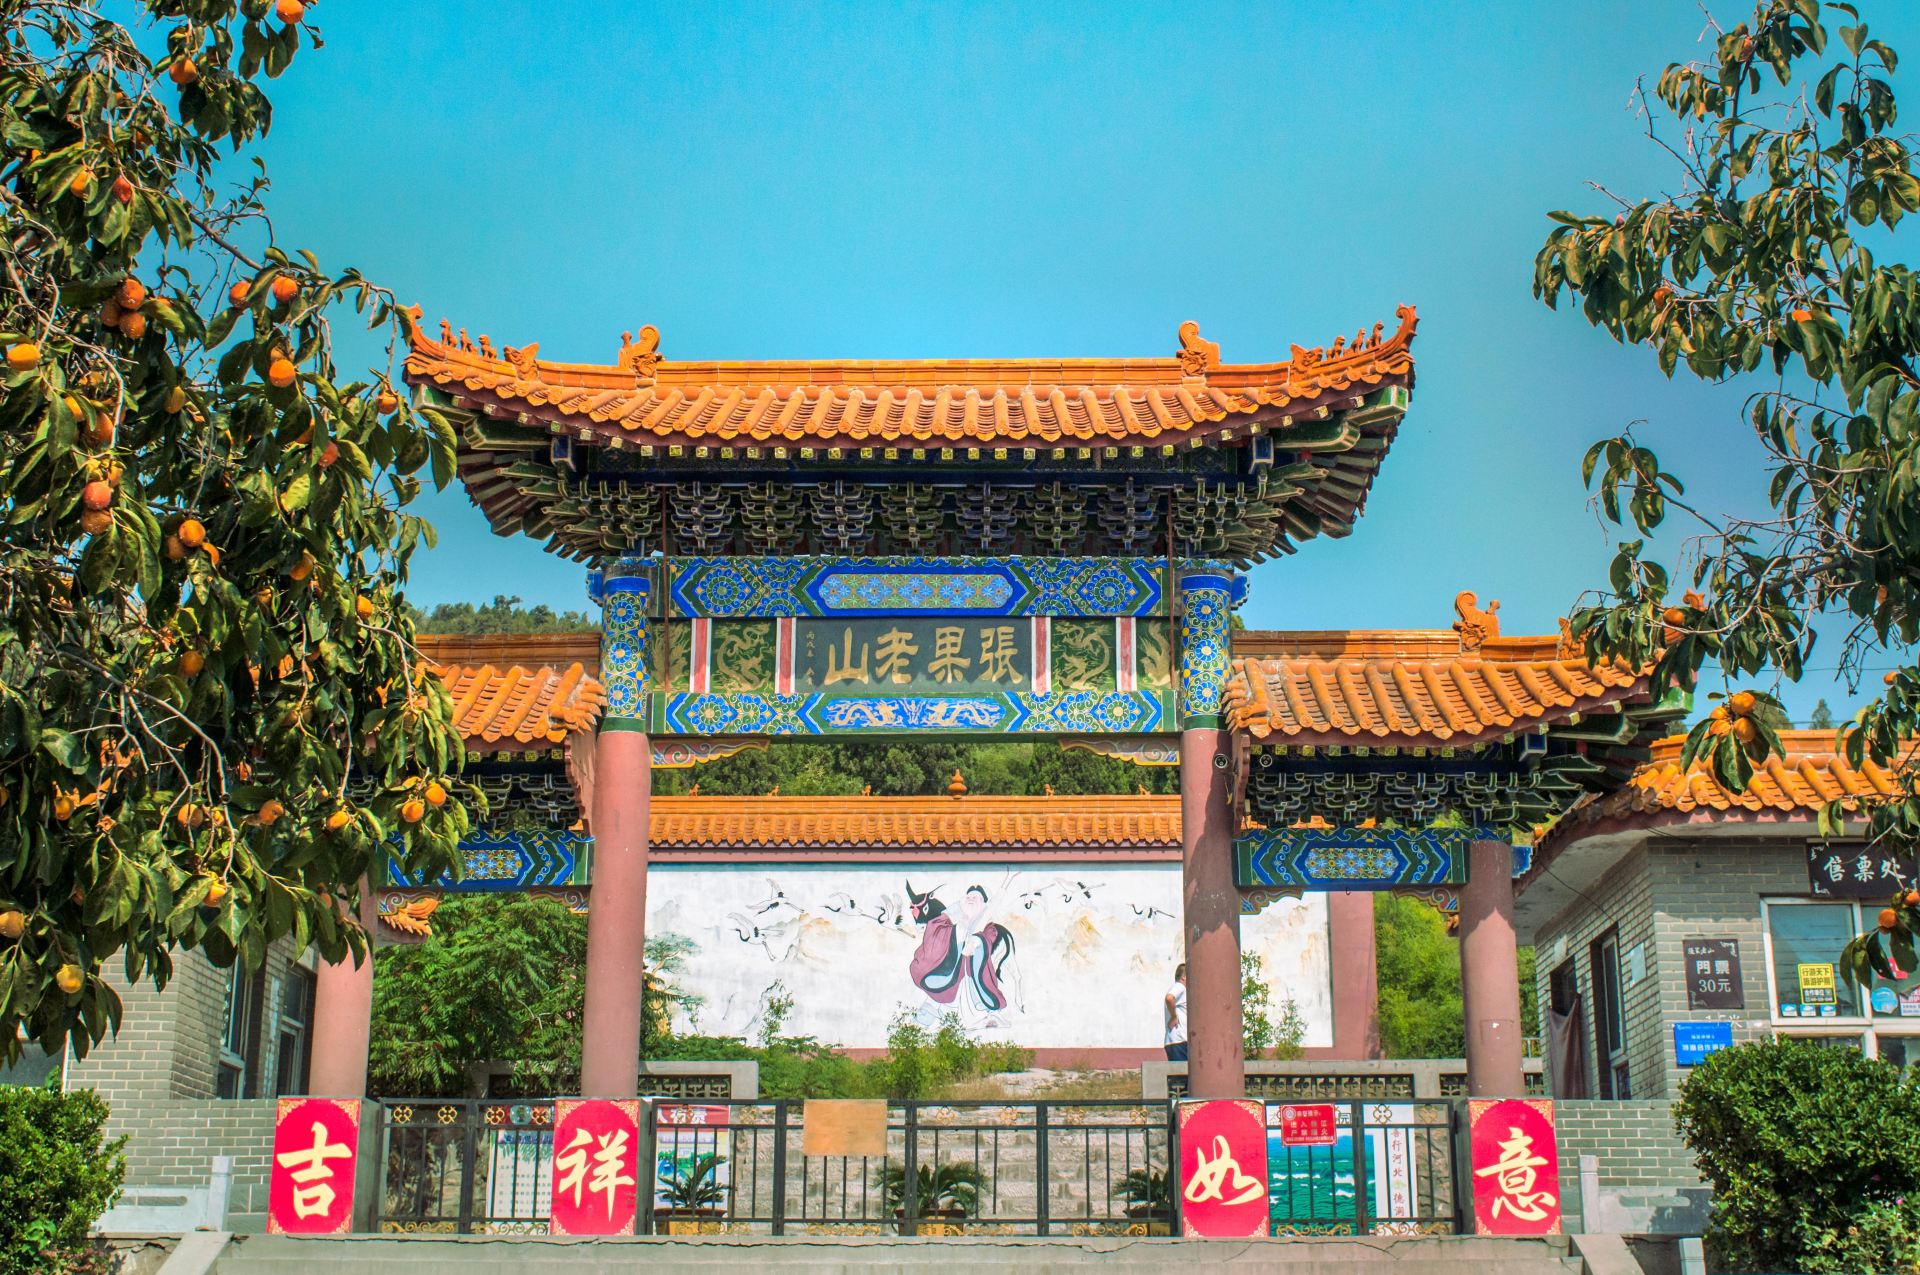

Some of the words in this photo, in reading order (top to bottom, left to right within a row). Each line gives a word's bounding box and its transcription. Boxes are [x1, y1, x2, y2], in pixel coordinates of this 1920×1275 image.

[1823, 855, 1906, 882] 售票处
[1698, 978, 1731, 992] 30元
[277, 1121, 352, 1221] 吉
[555, 1128, 635, 1223] 祥
[1184, 1135, 1264, 1205] 如
[1475, 1127, 1556, 1221] 意
